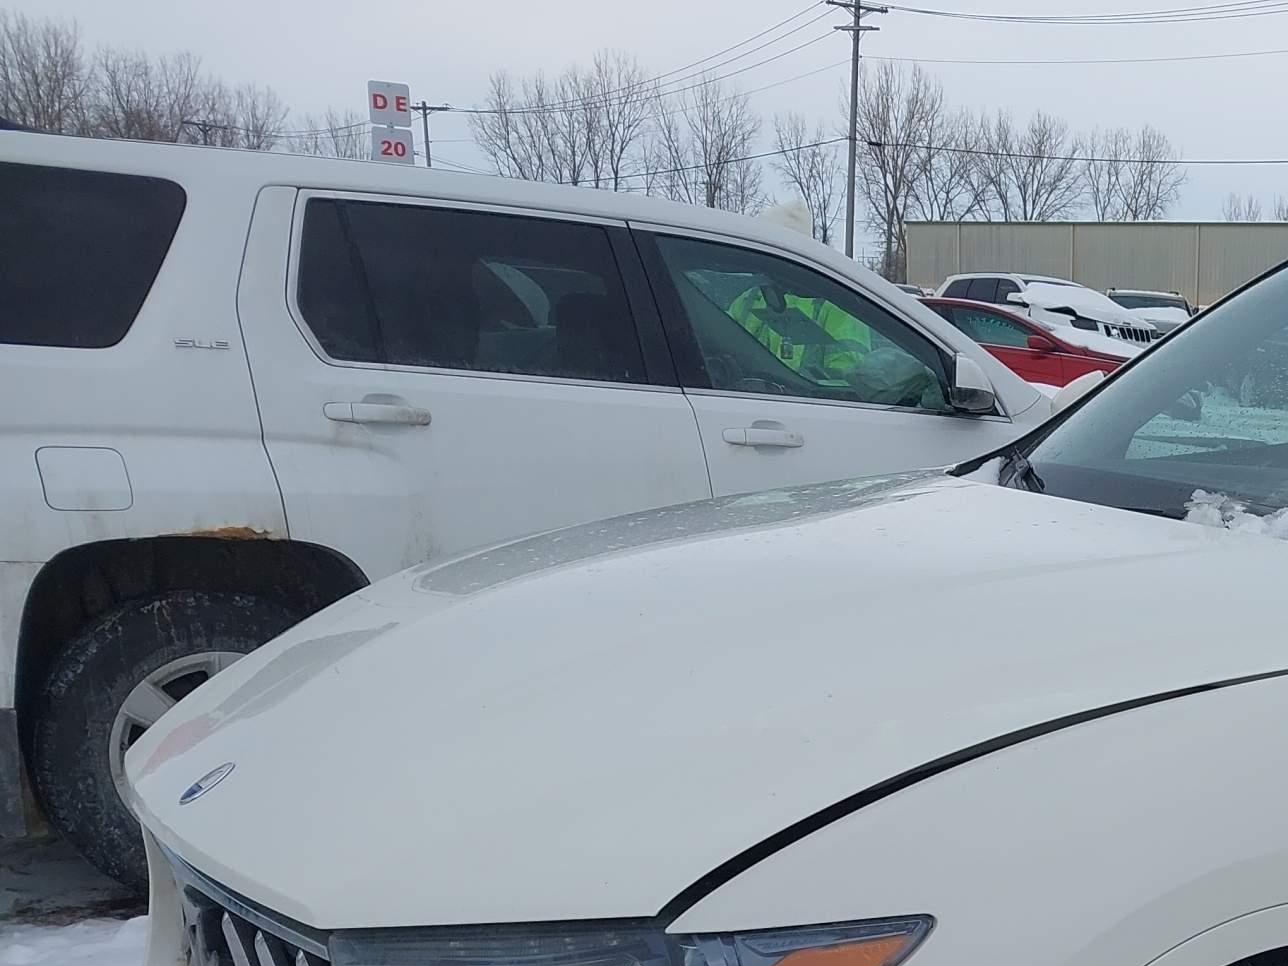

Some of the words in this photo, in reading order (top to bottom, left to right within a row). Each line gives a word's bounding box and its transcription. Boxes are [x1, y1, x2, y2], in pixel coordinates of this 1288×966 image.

[372, 93, 389, 110] D
[395, 96, 408, 112] E
[380, 140, 407, 157] 20
[174, 338, 230, 350] SLE
